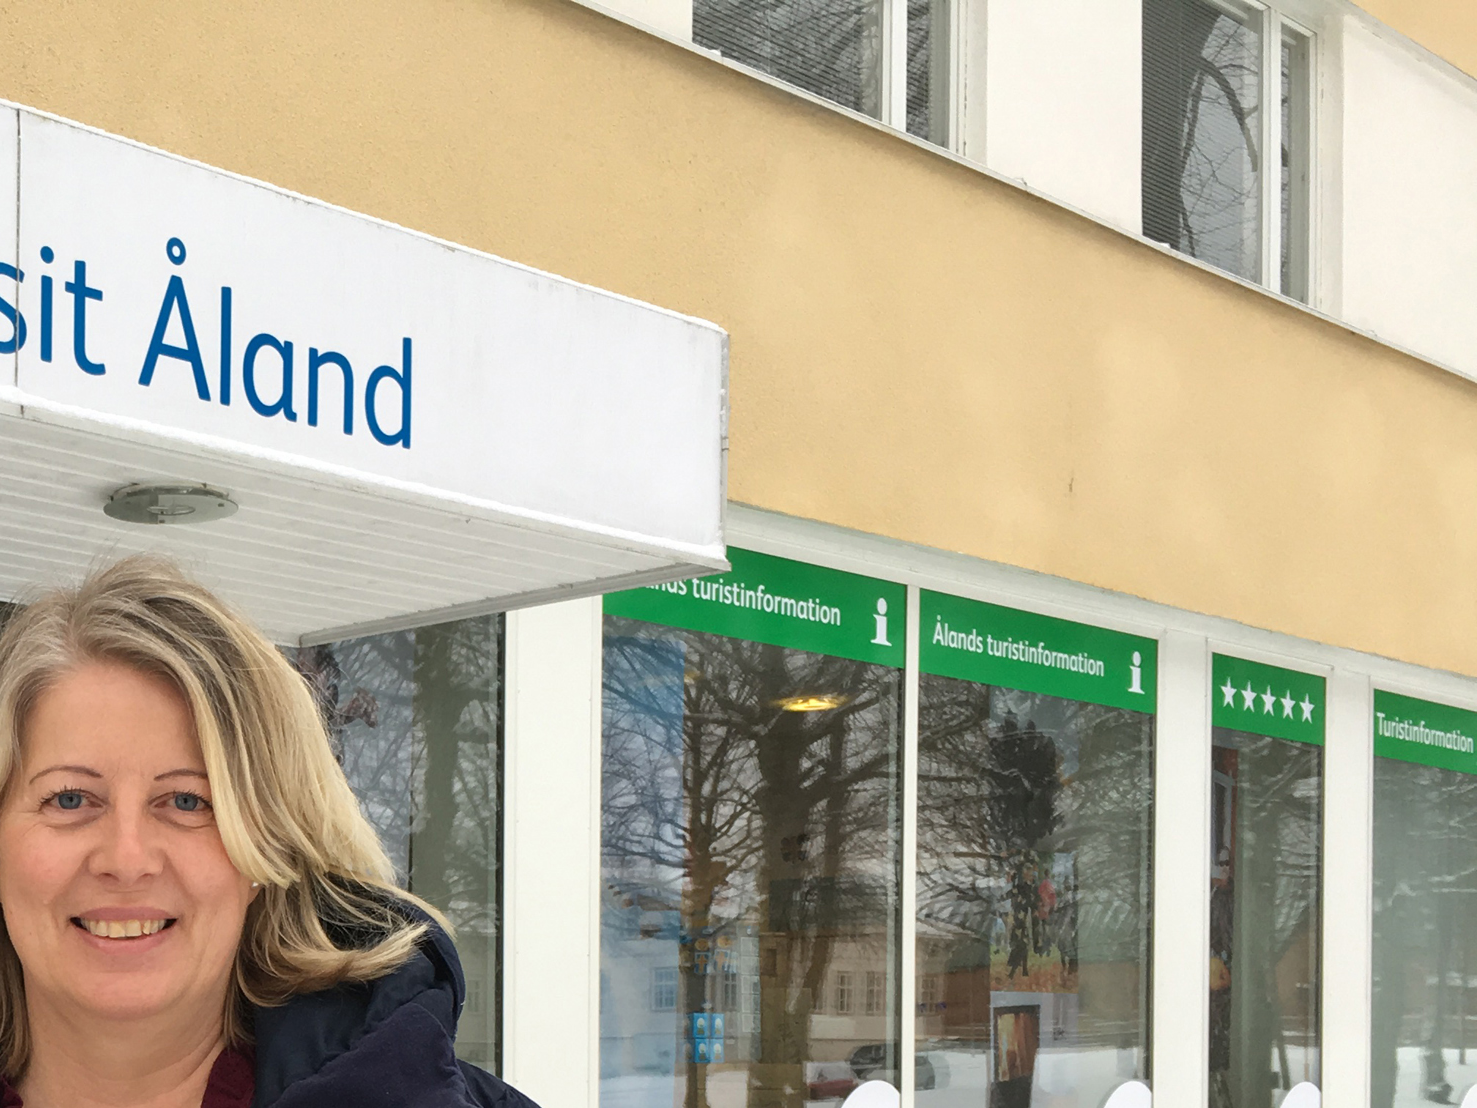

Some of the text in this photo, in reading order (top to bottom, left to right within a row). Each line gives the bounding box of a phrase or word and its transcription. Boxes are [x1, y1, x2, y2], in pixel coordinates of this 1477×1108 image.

[138, 236, 412, 449] Åland
[692, 578, 841, 626] turistinformation
[932, 614, 1105, 677] Ålands turistinformation
[1376, 711, 1474, 754] Turistinformation
